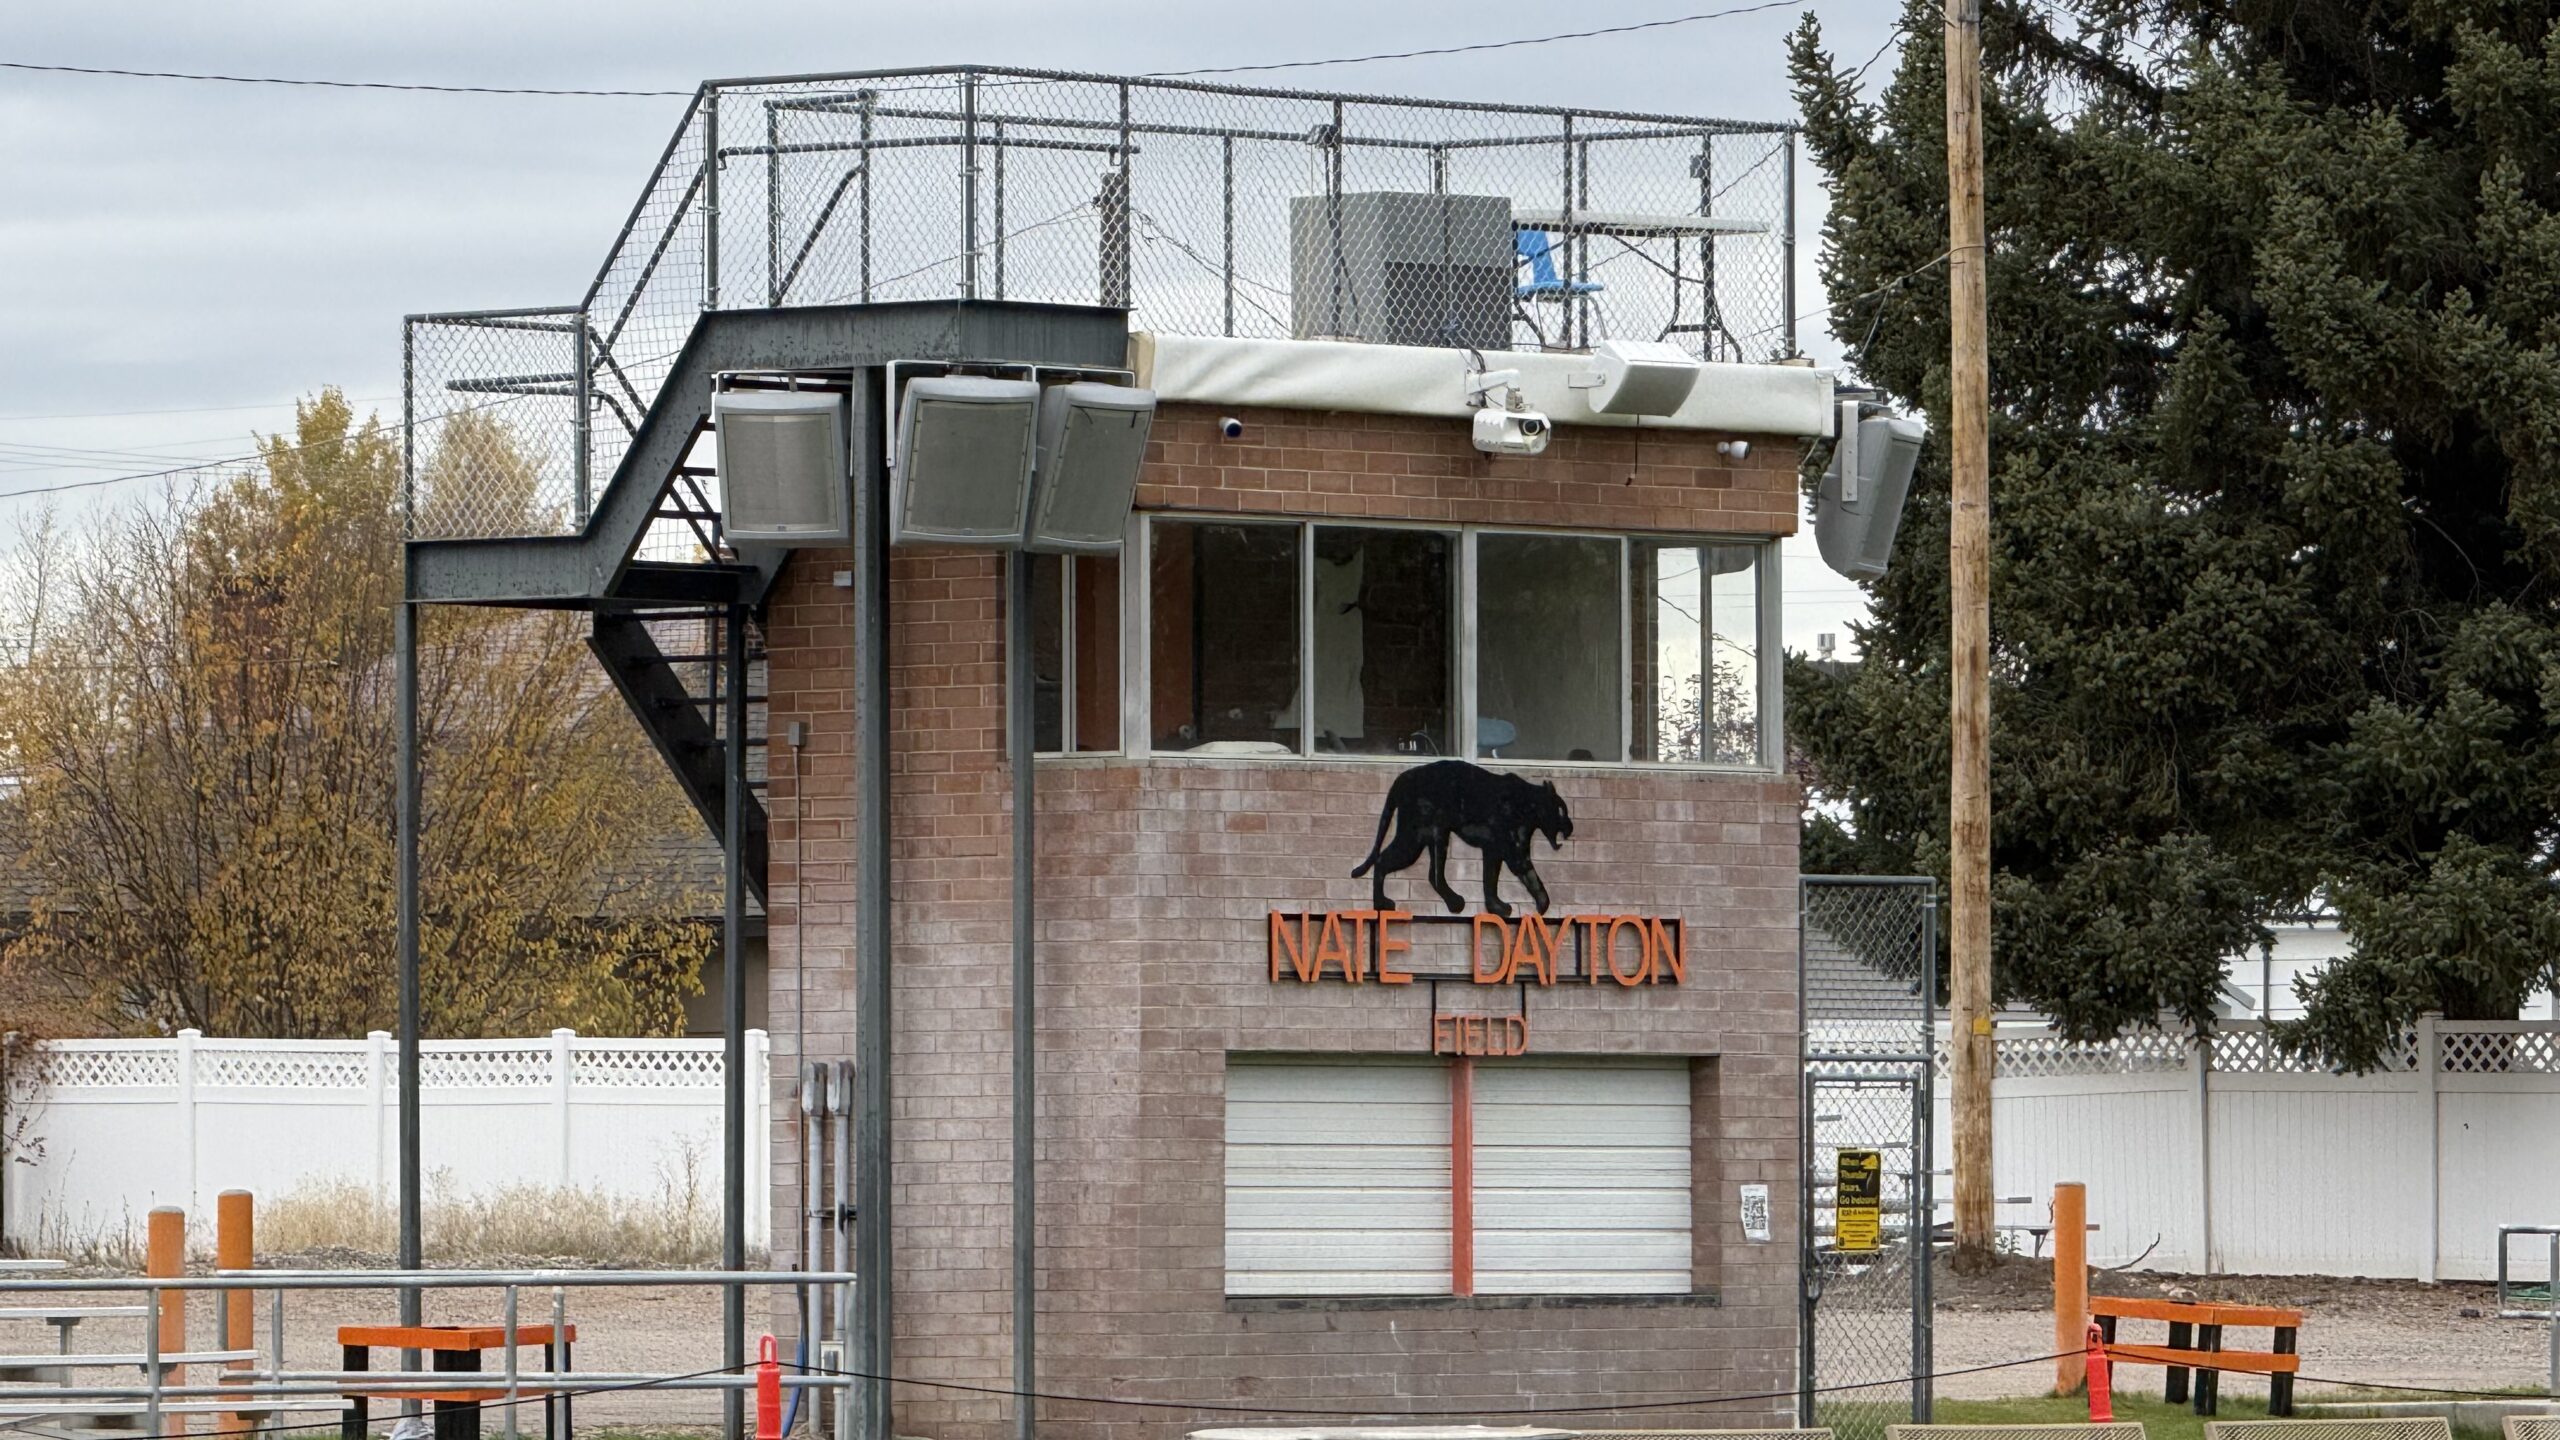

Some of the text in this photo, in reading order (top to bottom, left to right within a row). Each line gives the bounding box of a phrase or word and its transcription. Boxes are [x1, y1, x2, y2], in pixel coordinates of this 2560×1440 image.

[1270, 909, 1687, 987] NATE DAYTON
[1433, 1013, 1528, 1056] FIELD
